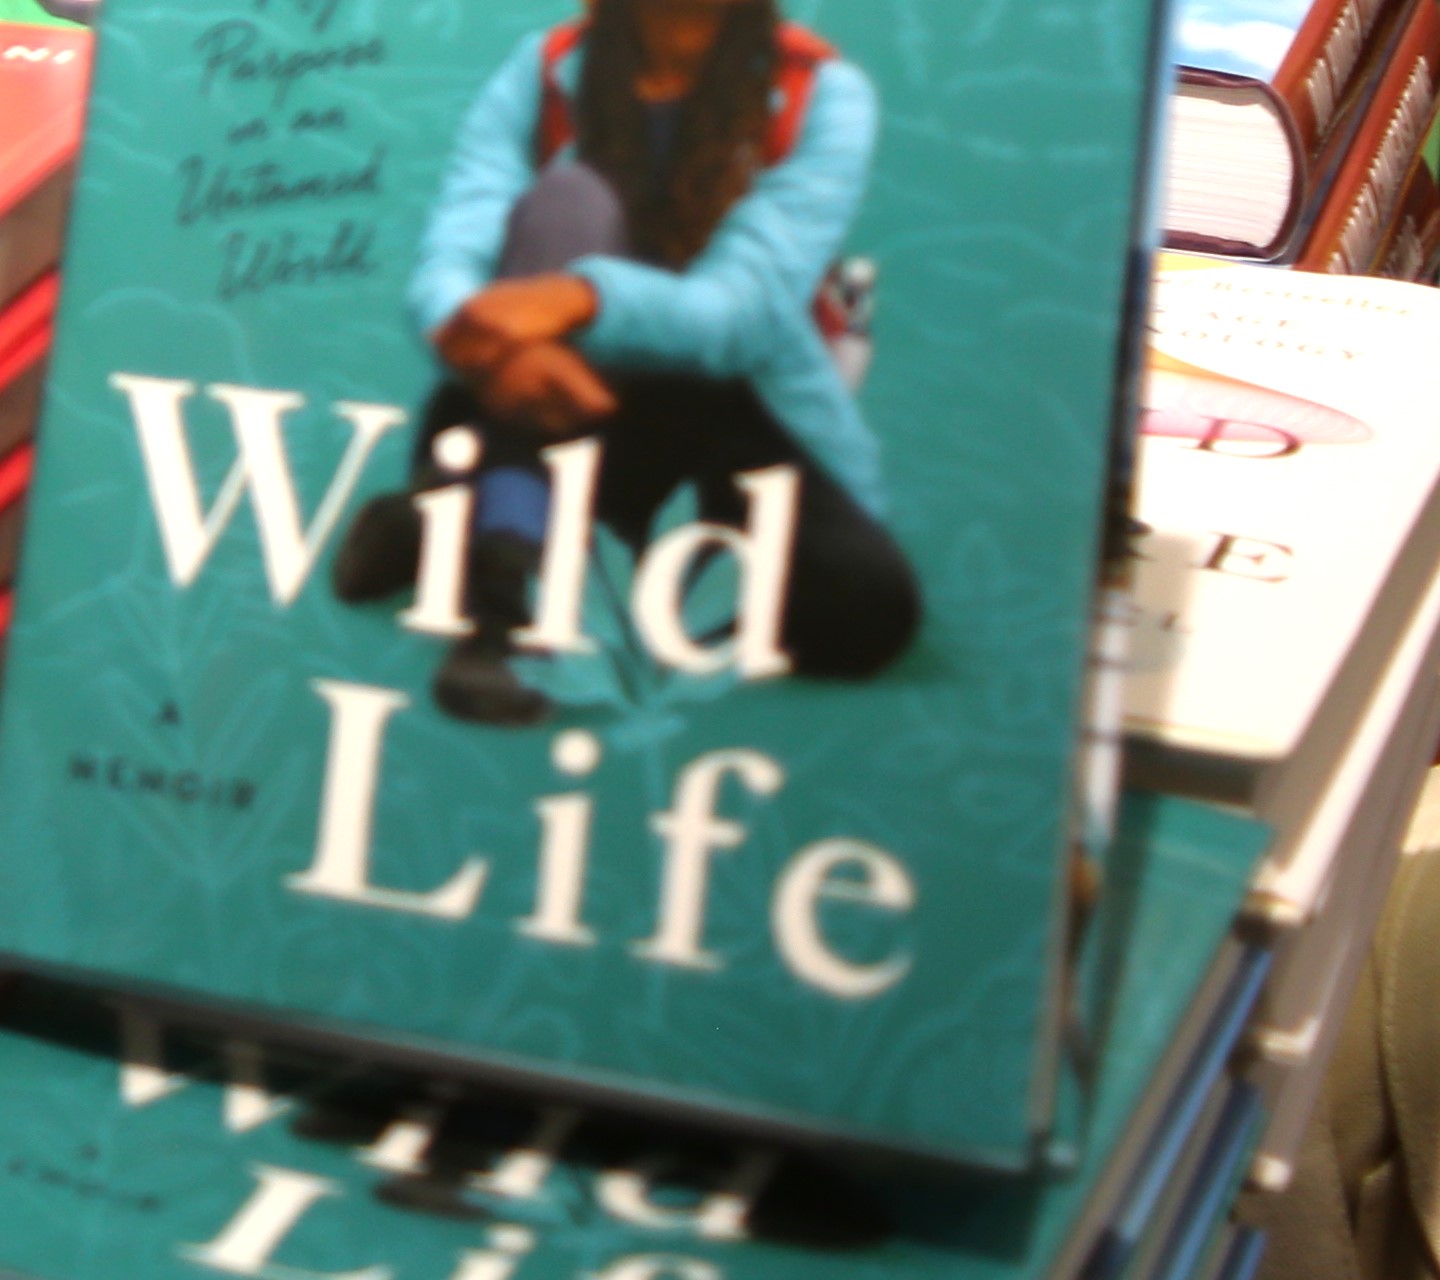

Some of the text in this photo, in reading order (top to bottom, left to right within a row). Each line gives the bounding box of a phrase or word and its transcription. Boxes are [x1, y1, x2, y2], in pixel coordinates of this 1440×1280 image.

[196, 22, 389, 97] Purpose
[173, 154, 384, 229] Untamed
[108, 370, 806, 684] Wild
[64, 751, 260, 813] MEMOIR
[284, 674, 919, 1003] Life
